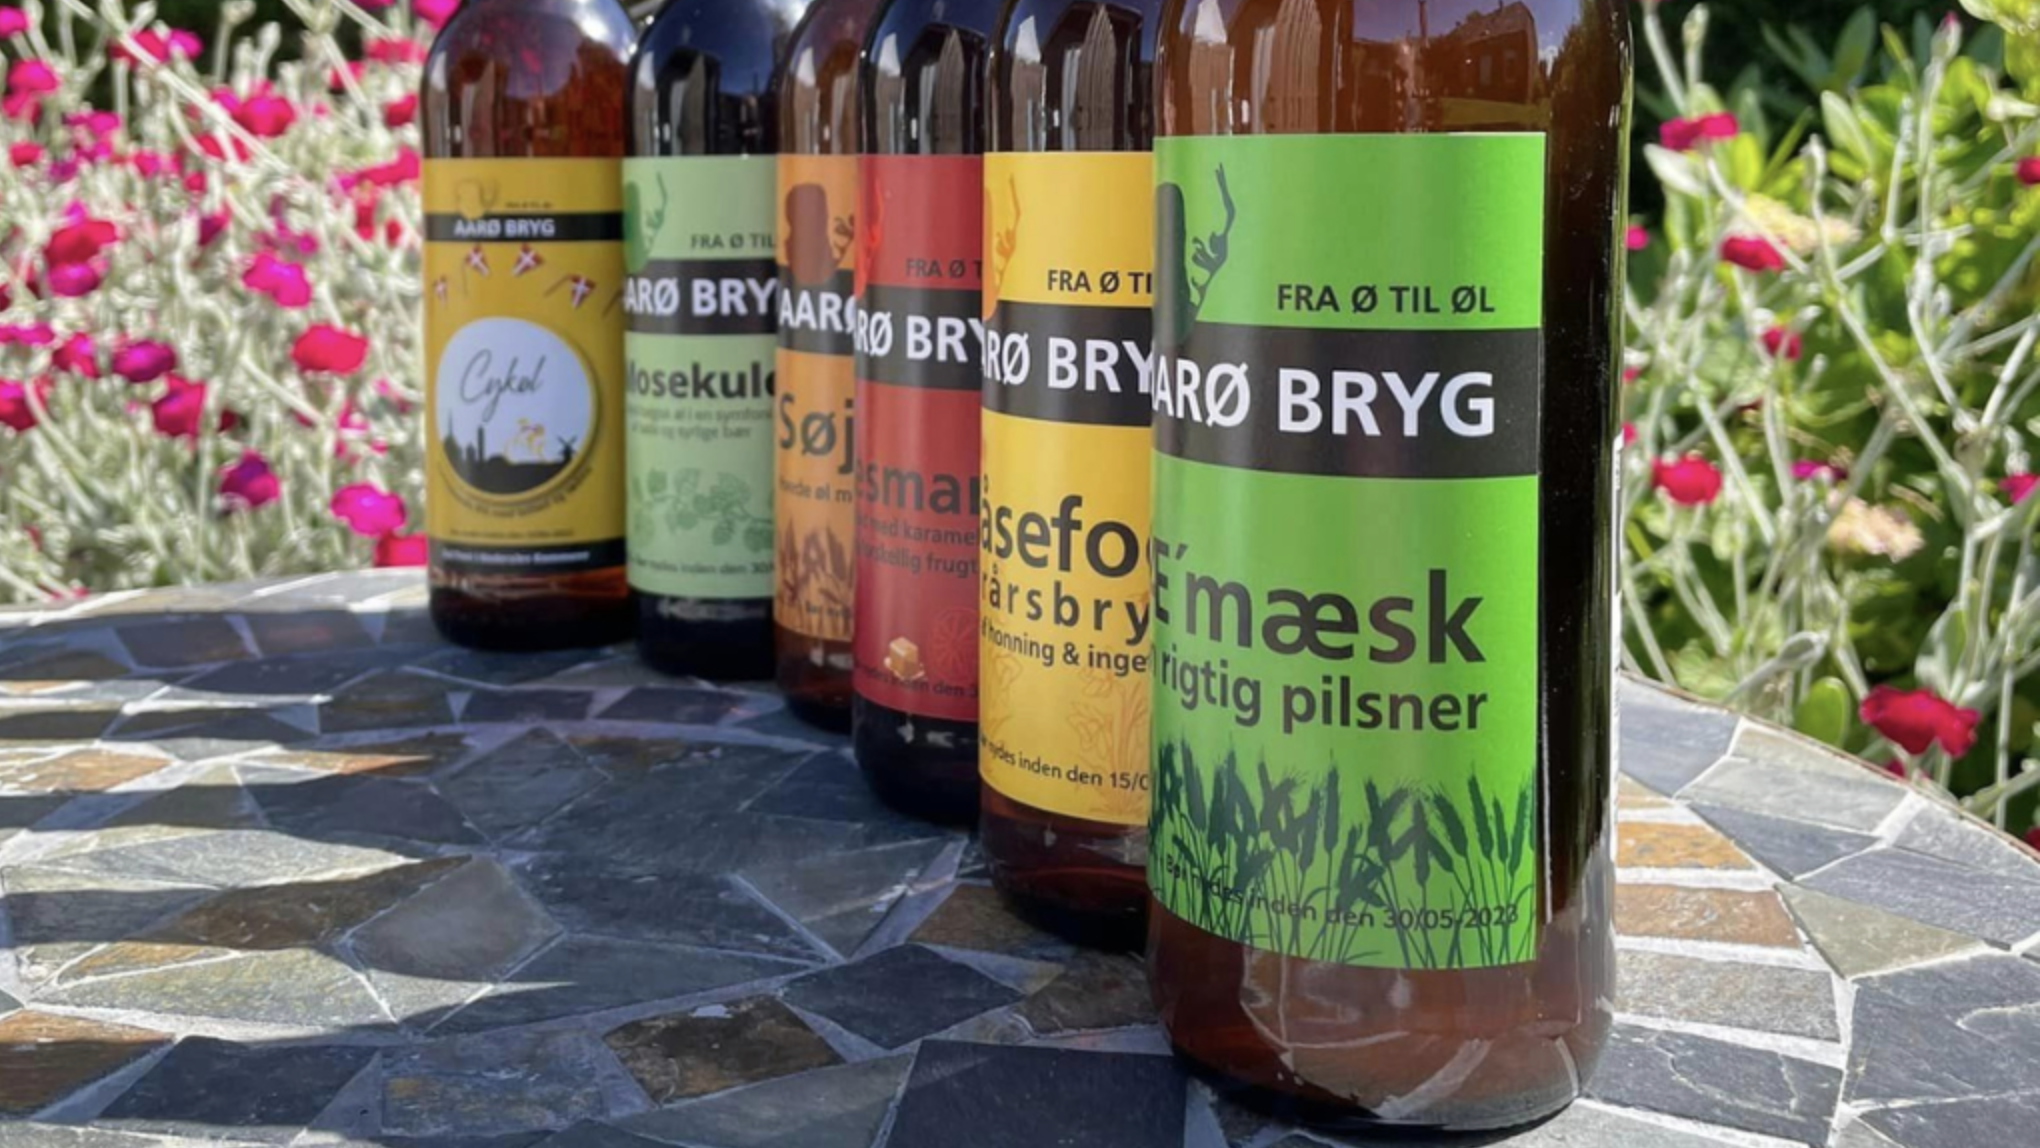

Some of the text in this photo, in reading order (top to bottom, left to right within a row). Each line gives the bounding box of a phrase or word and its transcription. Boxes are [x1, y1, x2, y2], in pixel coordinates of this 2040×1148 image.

[454, 219, 555, 237] AARØ BRYG
[691, 234, 724, 249] FRA
[730, 233, 744, 249] Ø
[906, 260, 942, 278] FRA
[948, 260, 966, 279] Ø
[1048, 269, 1091, 293] FRA
[1100, 270, 1120, 294] Ø
[692, 278, 781, 316] BRY
[1278, 284, 1495, 313] FRA Ø TIL ØL
[1152, 354, 1495, 437] ARØ BRYG
[1063, 642, 1079, 665] &
[1162, 642, 1261, 727] rigtig
[1283, 675, 1488, 734] pilsner
[1019, 751, 1062, 780] inden
[1066, 765, 1103, 787] den
